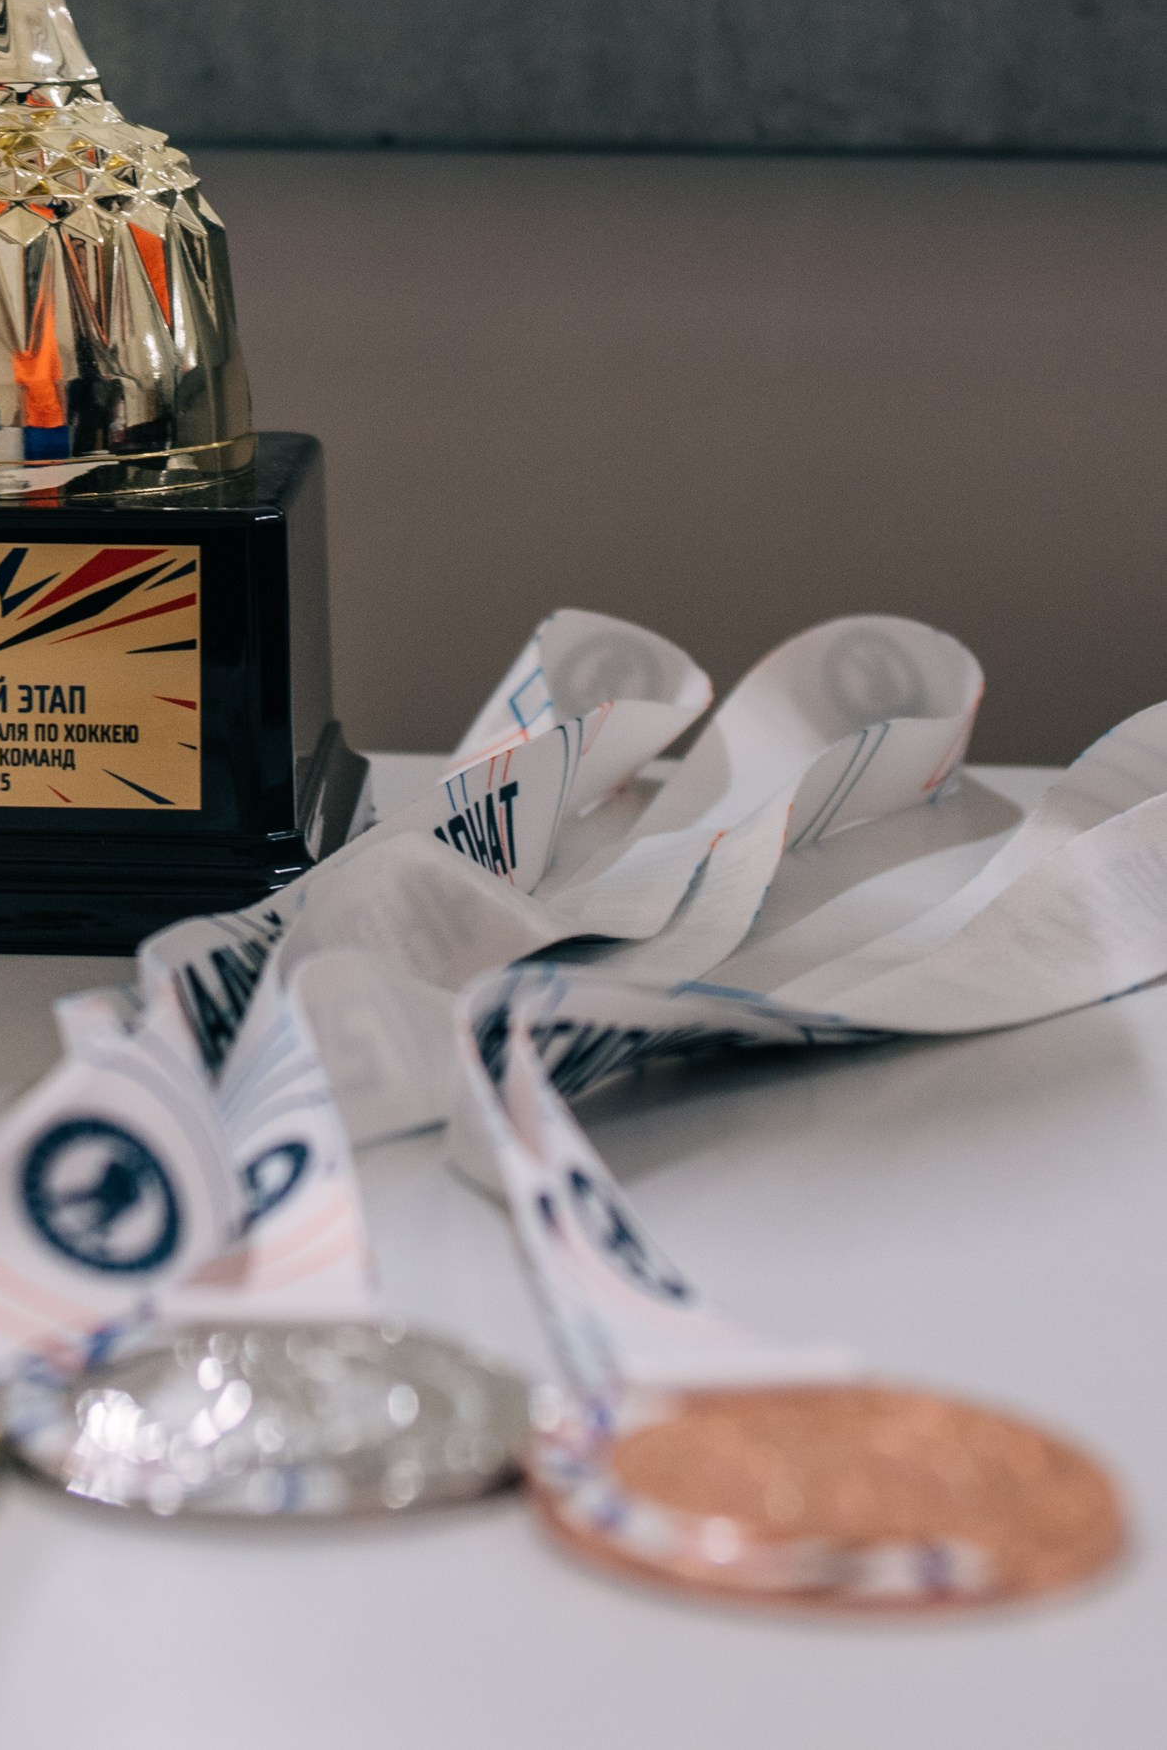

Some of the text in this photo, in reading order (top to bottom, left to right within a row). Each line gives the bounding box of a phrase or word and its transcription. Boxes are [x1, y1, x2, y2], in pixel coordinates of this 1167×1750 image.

[17, 684, 86, 714] ЭТАП
[35, 723, 58, 743] ПО
[63, 724, 139, 744] ХОККЕЮ
